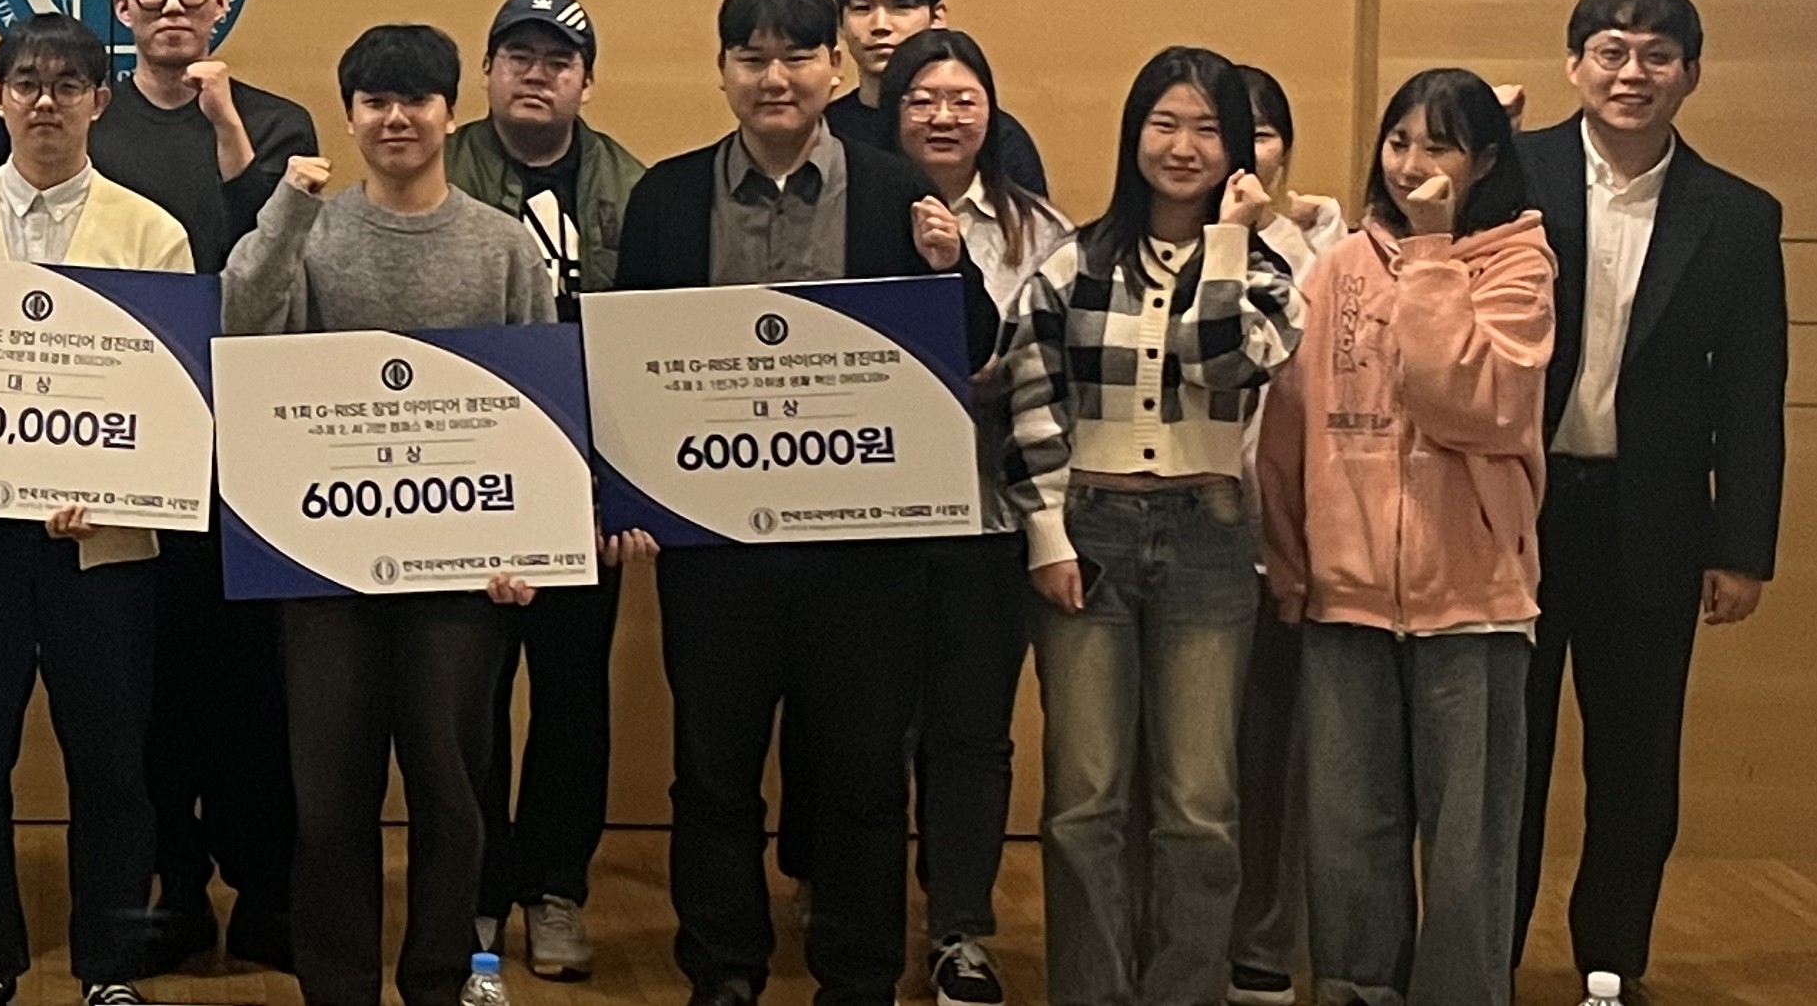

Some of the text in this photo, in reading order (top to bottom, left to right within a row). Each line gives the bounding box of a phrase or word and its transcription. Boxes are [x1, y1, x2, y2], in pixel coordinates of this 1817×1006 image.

[40, 332, 95, 349] 아이디어
[689, 357, 743, 373] G-RISE
[779, 353, 837, 370] 아이디어
[316, 402, 368, 418] G-RISE
[403, 398, 460, 415] 아이디어
[676, 426, 895, 472] 600,000원
[301, 473, 514, 519] 600,000원
